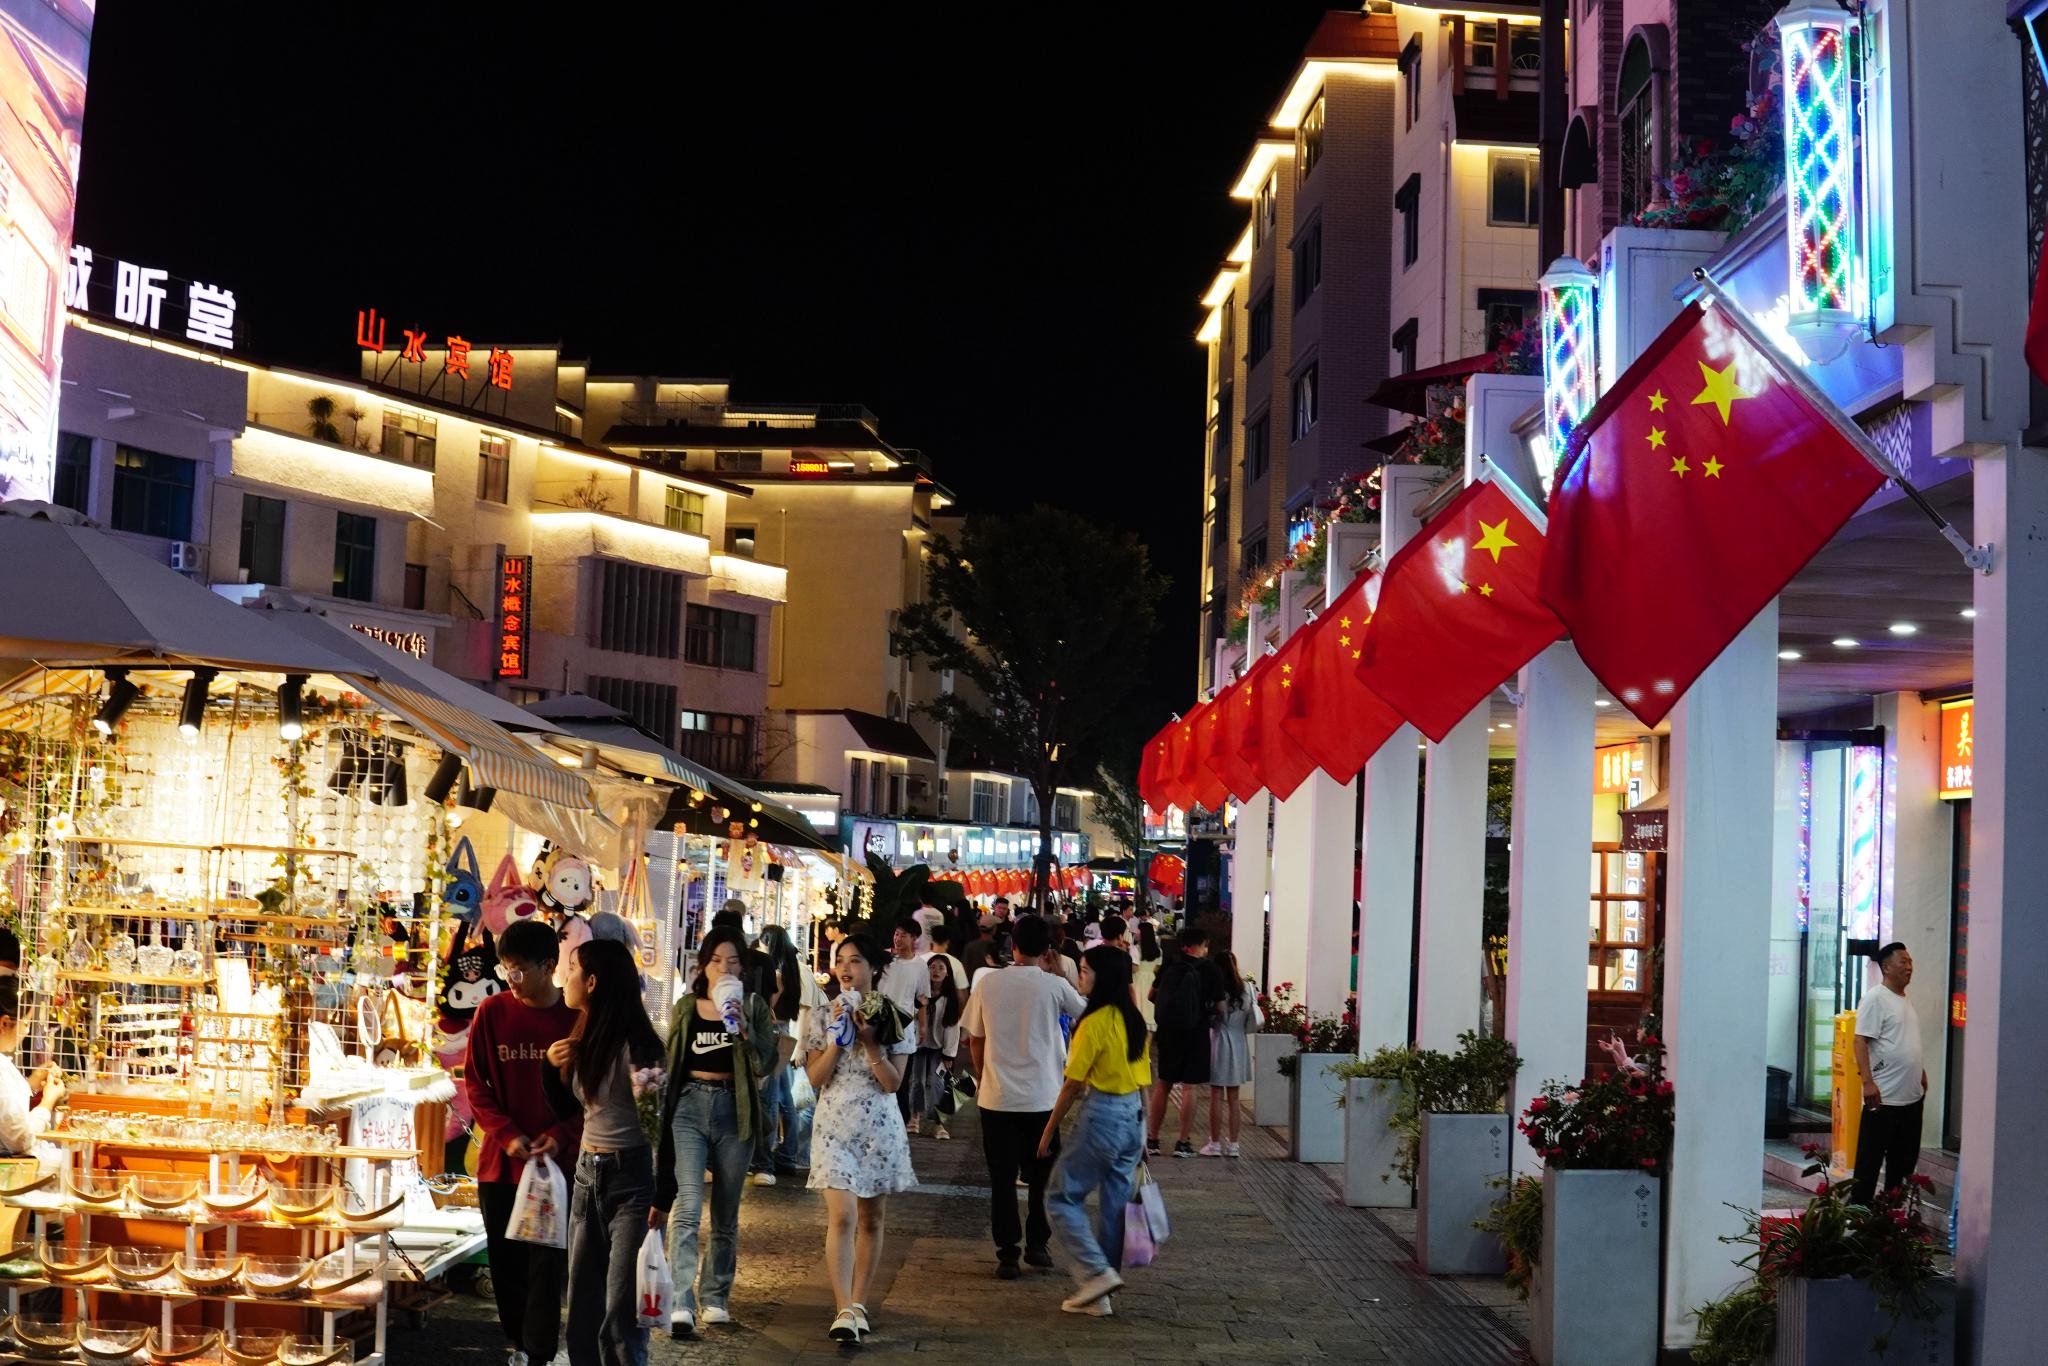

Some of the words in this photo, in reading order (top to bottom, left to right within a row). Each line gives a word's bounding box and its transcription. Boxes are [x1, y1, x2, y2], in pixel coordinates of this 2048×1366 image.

[357, 308, 514, 391] 山水宾馆
[502, 559, 522, 669] 山水概念宾馆
[696, 1032, 729, 1045] NIKE
